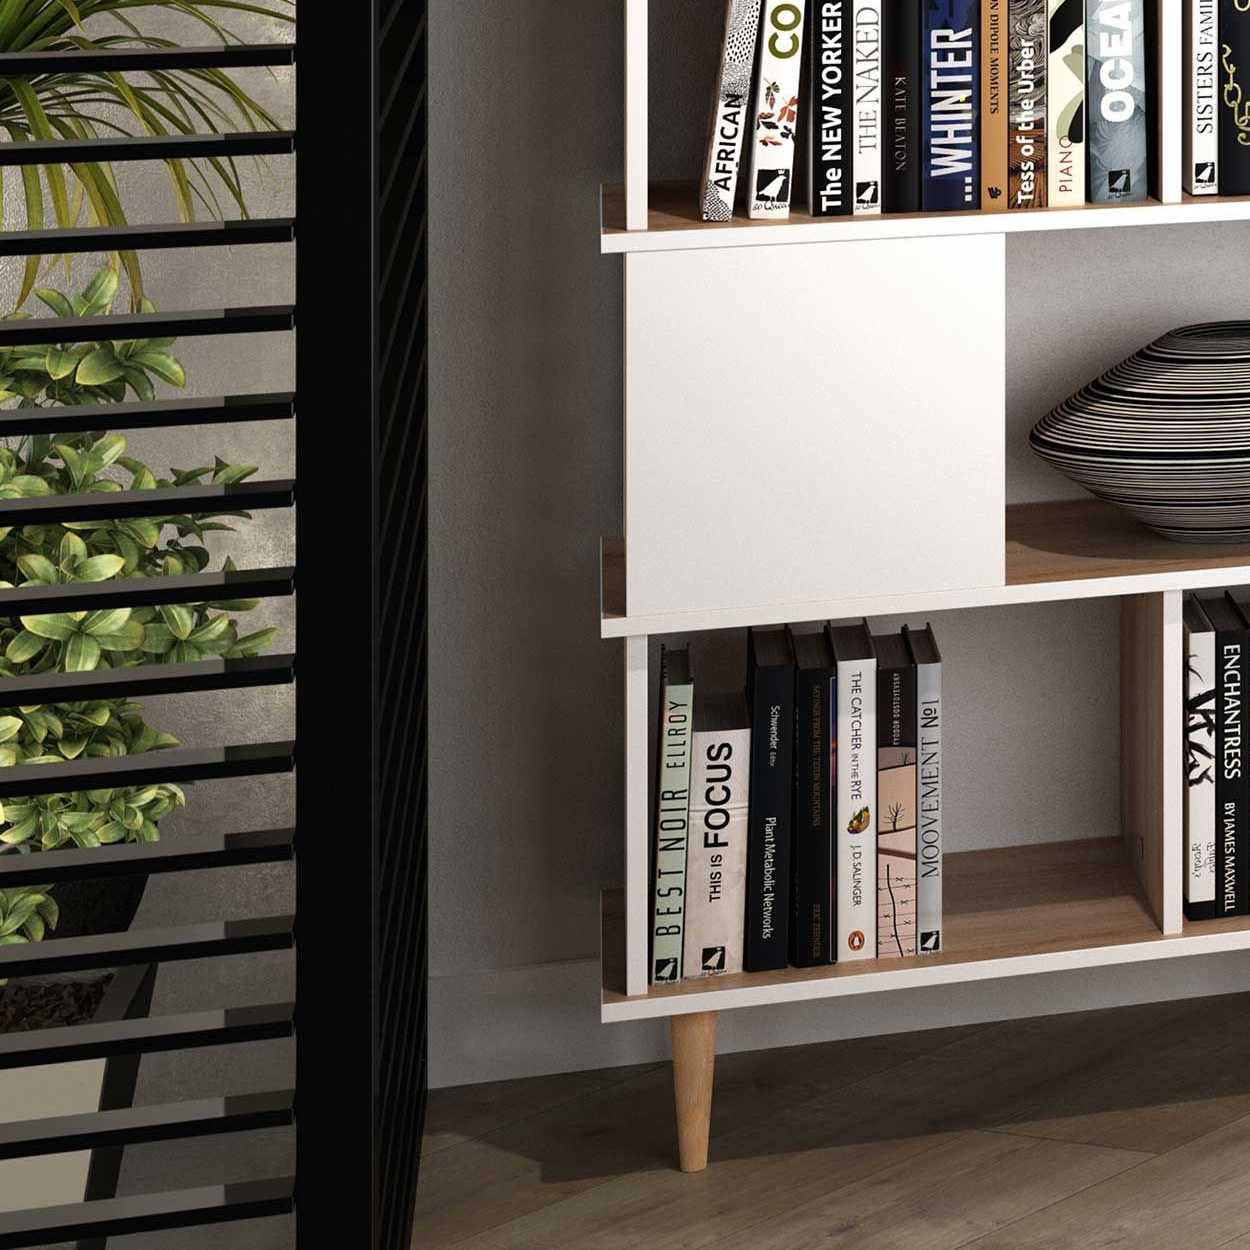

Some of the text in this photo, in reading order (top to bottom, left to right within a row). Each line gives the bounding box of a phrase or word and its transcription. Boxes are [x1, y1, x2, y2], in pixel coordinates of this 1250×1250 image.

[856, 7, 879, 104] NAKED
[990, 14, 999, 54] DIPOLE
[822, 1, 842, 211] The NEW YORKER
[895, 77, 906, 171] KATE BEATON
[990, 57, 999, 114] MOMENTS
[1016, 39, 1034, 204] Tess of the Urber
[1196, 52, 1213, 134] SISTERS
[714, 94, 743, 191] AFRICAN
[859, 110, 877, 154] THE
[1059, 136, 1073, 192] PIANO
[770, 705, 780, 749] Schwender
[851, 672, 862, 694] THE
[851, 697, 862, 750] CATCHER
[851, 781, 862, 800] RYE
[852, 753, 859, 762] IN
[1224, 644, 1241, 912] ENCHANTRESS BY JAMES MAXWELL
[655, 701, 689, 937] BEST NOIR ELLROY
[704, 742, 733, 903] THIS IS FOCUS
[920, 736, 939, 879] MOOVEMENT
[762, 817, 777, 939] Plant Metabolic Networks
